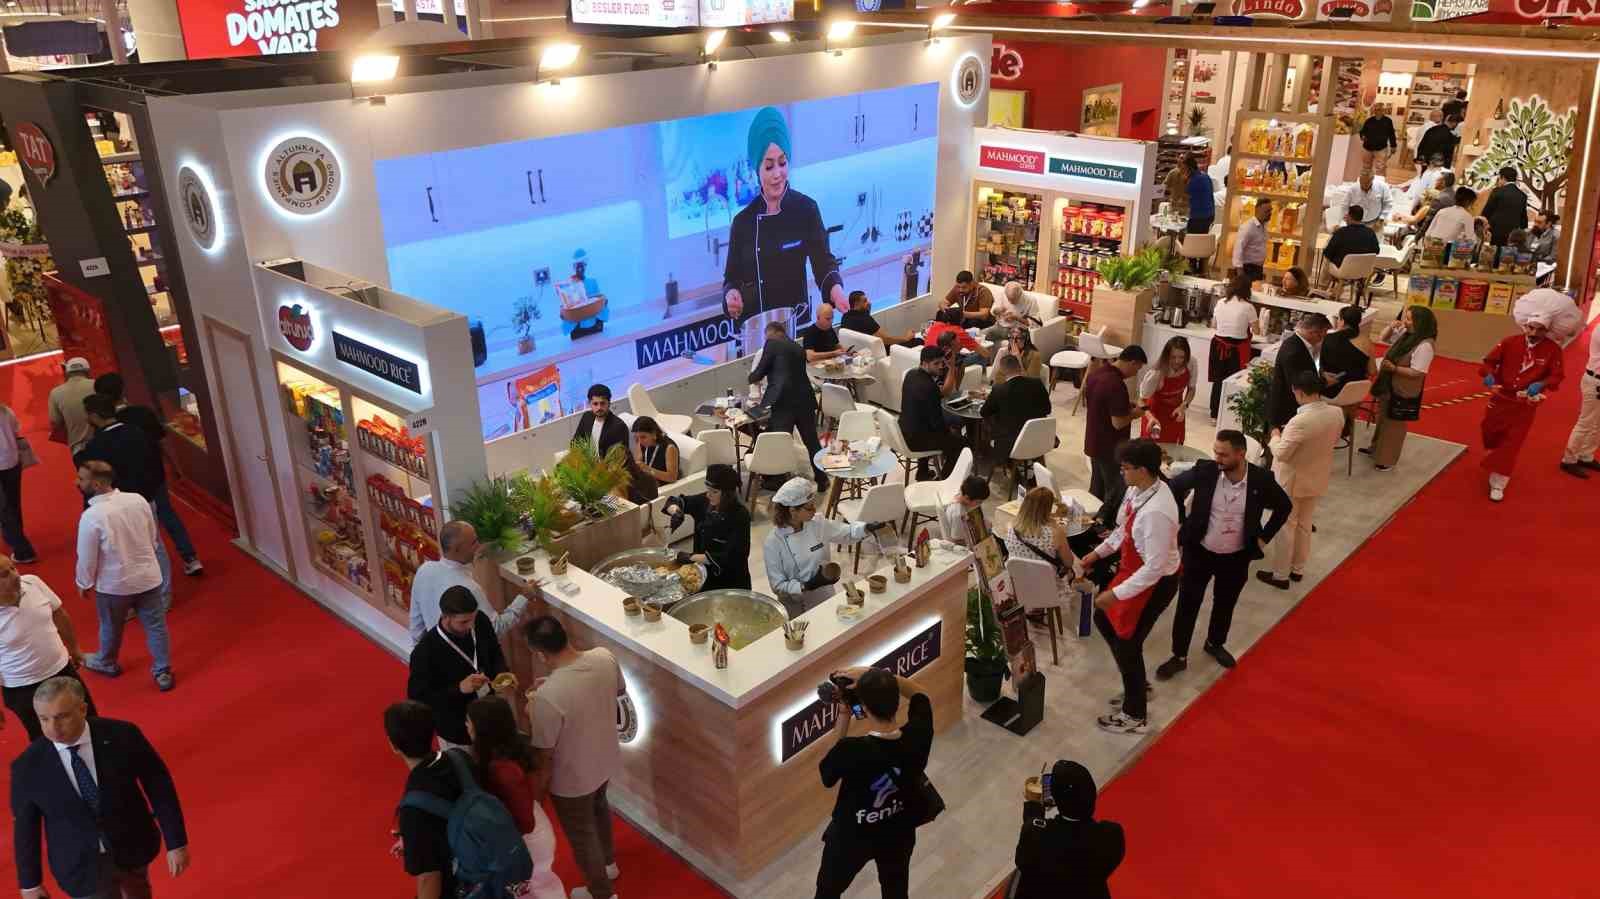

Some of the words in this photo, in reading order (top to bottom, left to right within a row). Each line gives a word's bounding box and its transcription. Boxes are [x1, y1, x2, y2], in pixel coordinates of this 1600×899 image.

[226, 0, 340, 46] DOMATES
[258, 29, 318, 55] VAR!
[19, 131, 48, 162] TAT
[276, 144, 325, 165] ALTUNKAYA
[986, 151, 1037, 165] MAHMOOD
[1061, 163, 1106, 176] MAHMOOD
[339, 342, 388, 375] MAHMOOD
[390, 362, 411, 384] RICE
[897, 640, 929, 678] RICE
